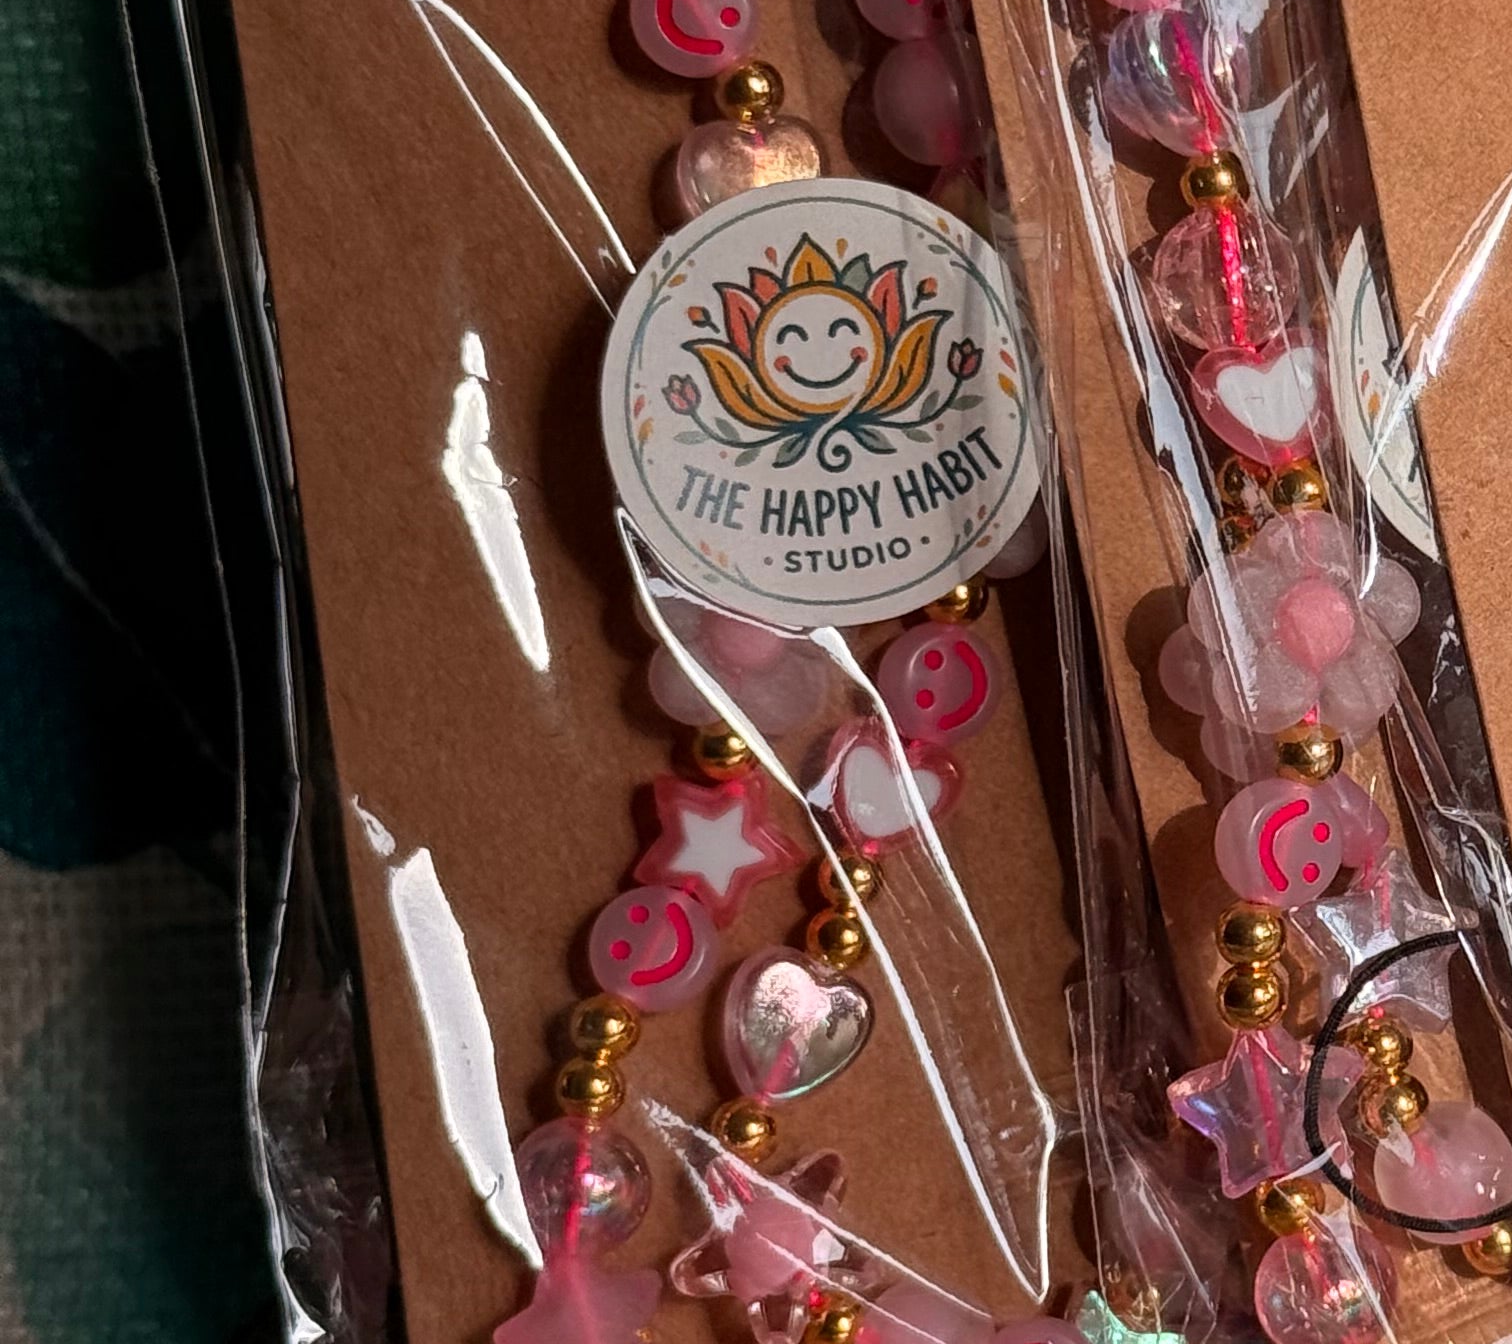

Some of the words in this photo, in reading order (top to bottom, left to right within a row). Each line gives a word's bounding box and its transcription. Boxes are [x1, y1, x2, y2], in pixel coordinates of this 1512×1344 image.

[676, 465, 750, 530] THE
[760, 480, 884, 537] HAPPY
[894, 426, 1003, 519] HABIT
[784, 537, 911, 573] STUDIO
